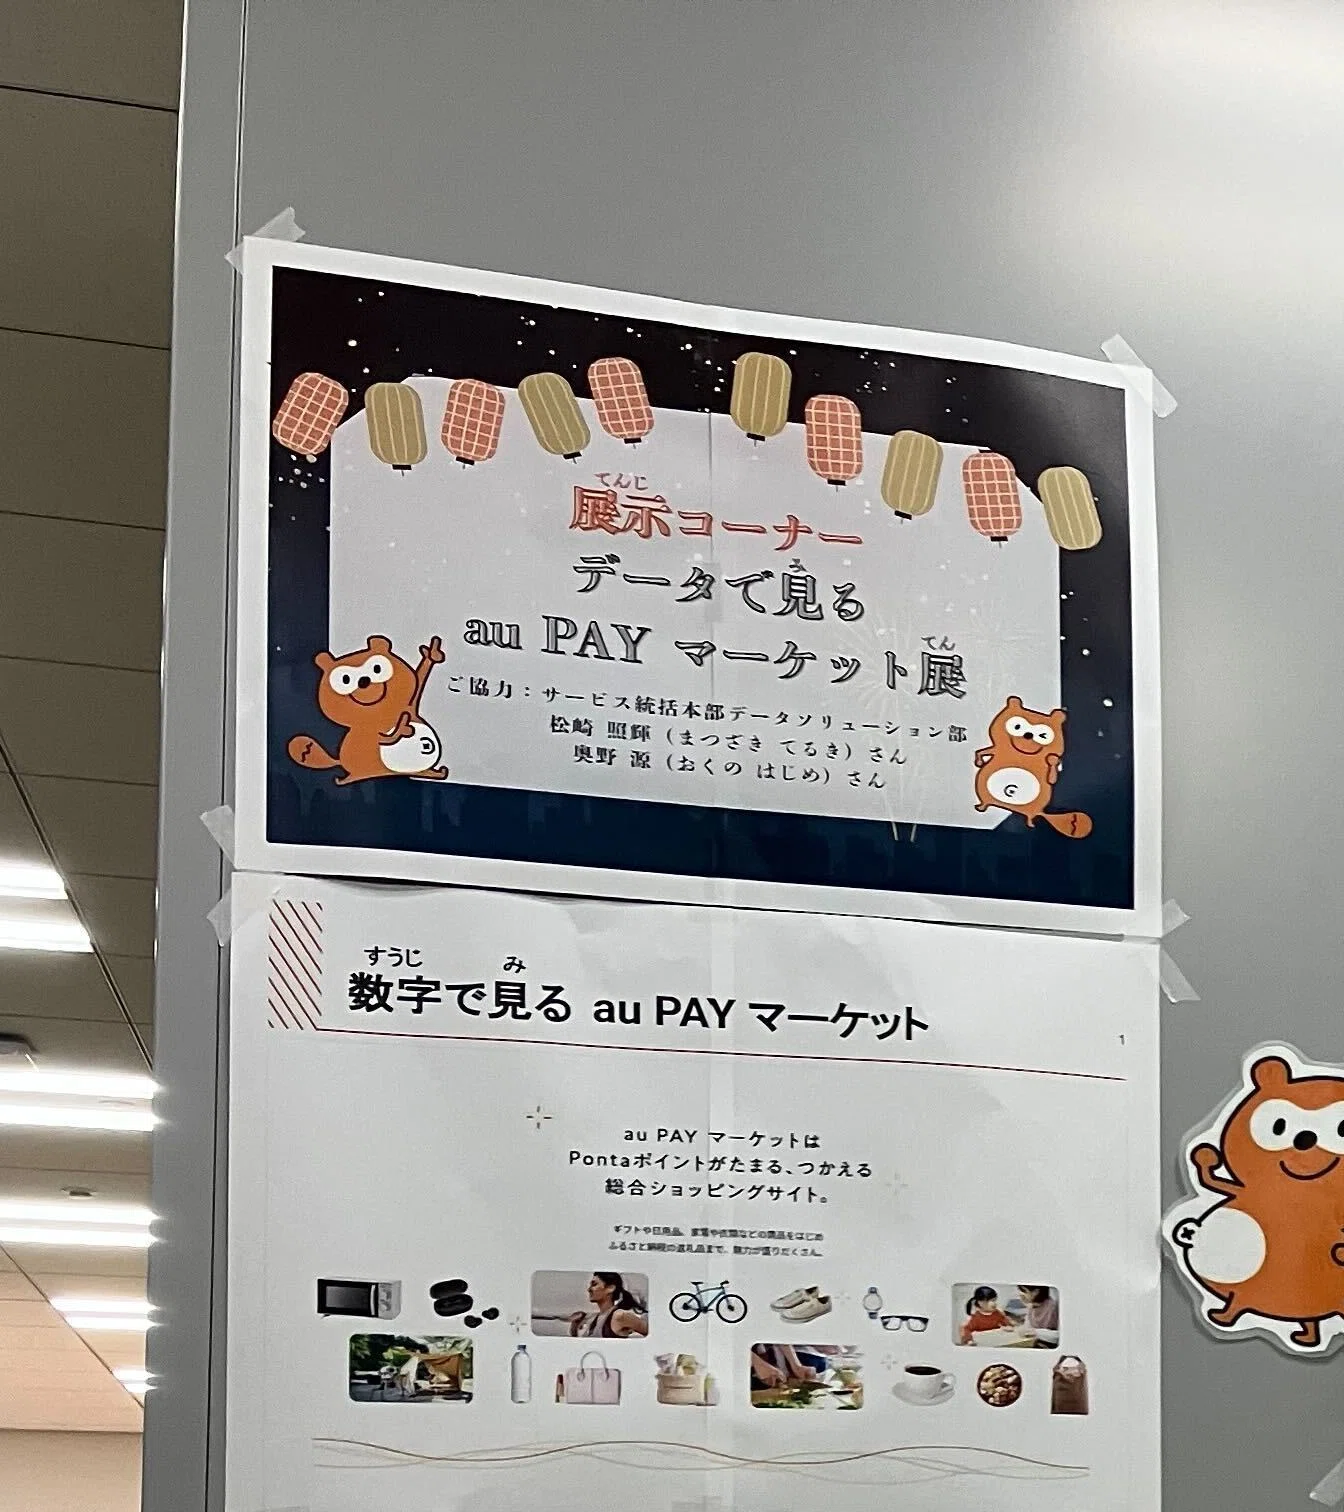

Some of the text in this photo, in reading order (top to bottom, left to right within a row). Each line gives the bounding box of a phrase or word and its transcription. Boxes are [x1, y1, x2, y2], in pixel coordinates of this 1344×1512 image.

[570, 485, 863, 551] 展示コーナー
[572, 554, 864, 622] データで見る
[463, 614, 967, 698] au PAY マーケット展
[574, 744, 886, 789] 奥野 源 さん
[870, 745, 907, 765] さん
[363, 945, 422, 968] すうじ
[503, 956, 527, 974] み
[348, 971, 929, 1041] 数字で見る au PAY マーケット
[624, 1129, 821, 1150] au PAY マーケットは
